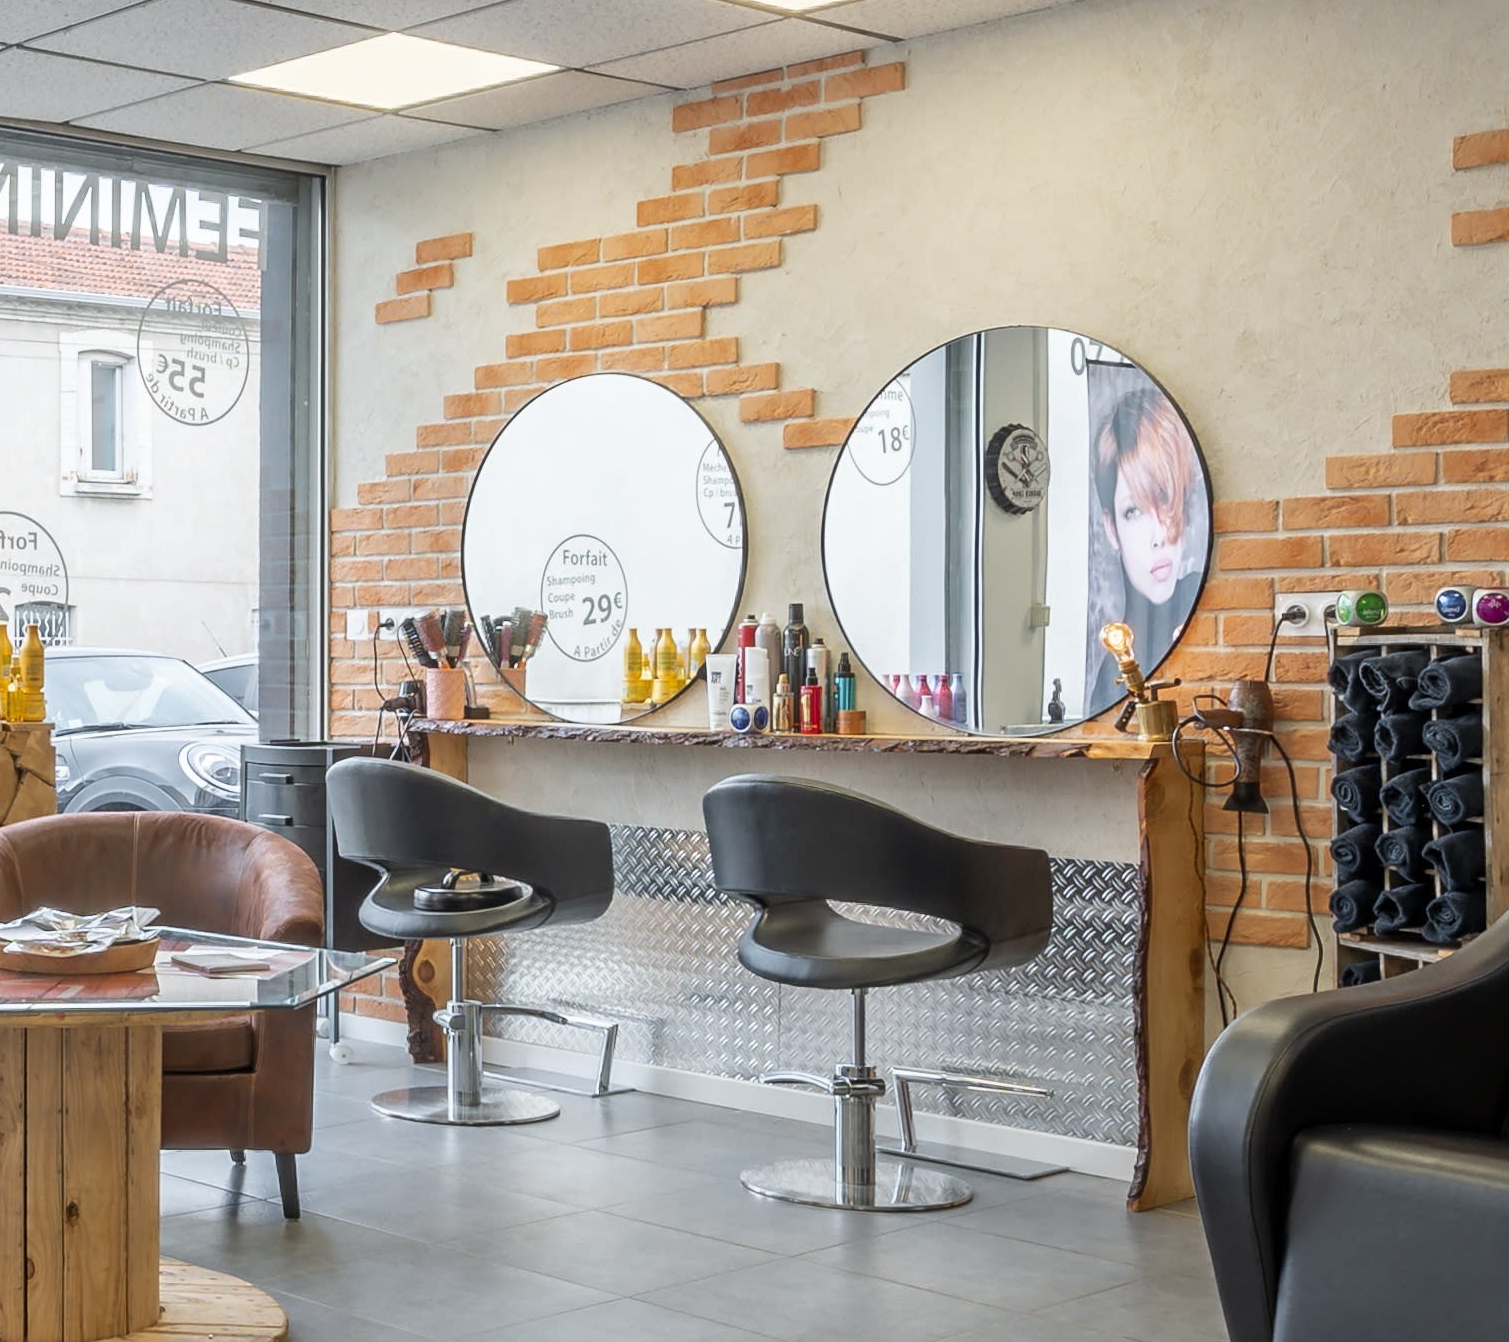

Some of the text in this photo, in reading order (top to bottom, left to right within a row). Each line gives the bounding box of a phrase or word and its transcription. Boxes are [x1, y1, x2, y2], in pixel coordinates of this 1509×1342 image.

[878, 425, 910, 454] 18€
[562, 549, 608, 567] Forfait
[546, 573, 595, 587] Shampoing
[548, 592, 575, 604] Coupe
[549, 608, 574, 620] Brush
[582, 591, 623, 626] 29€
